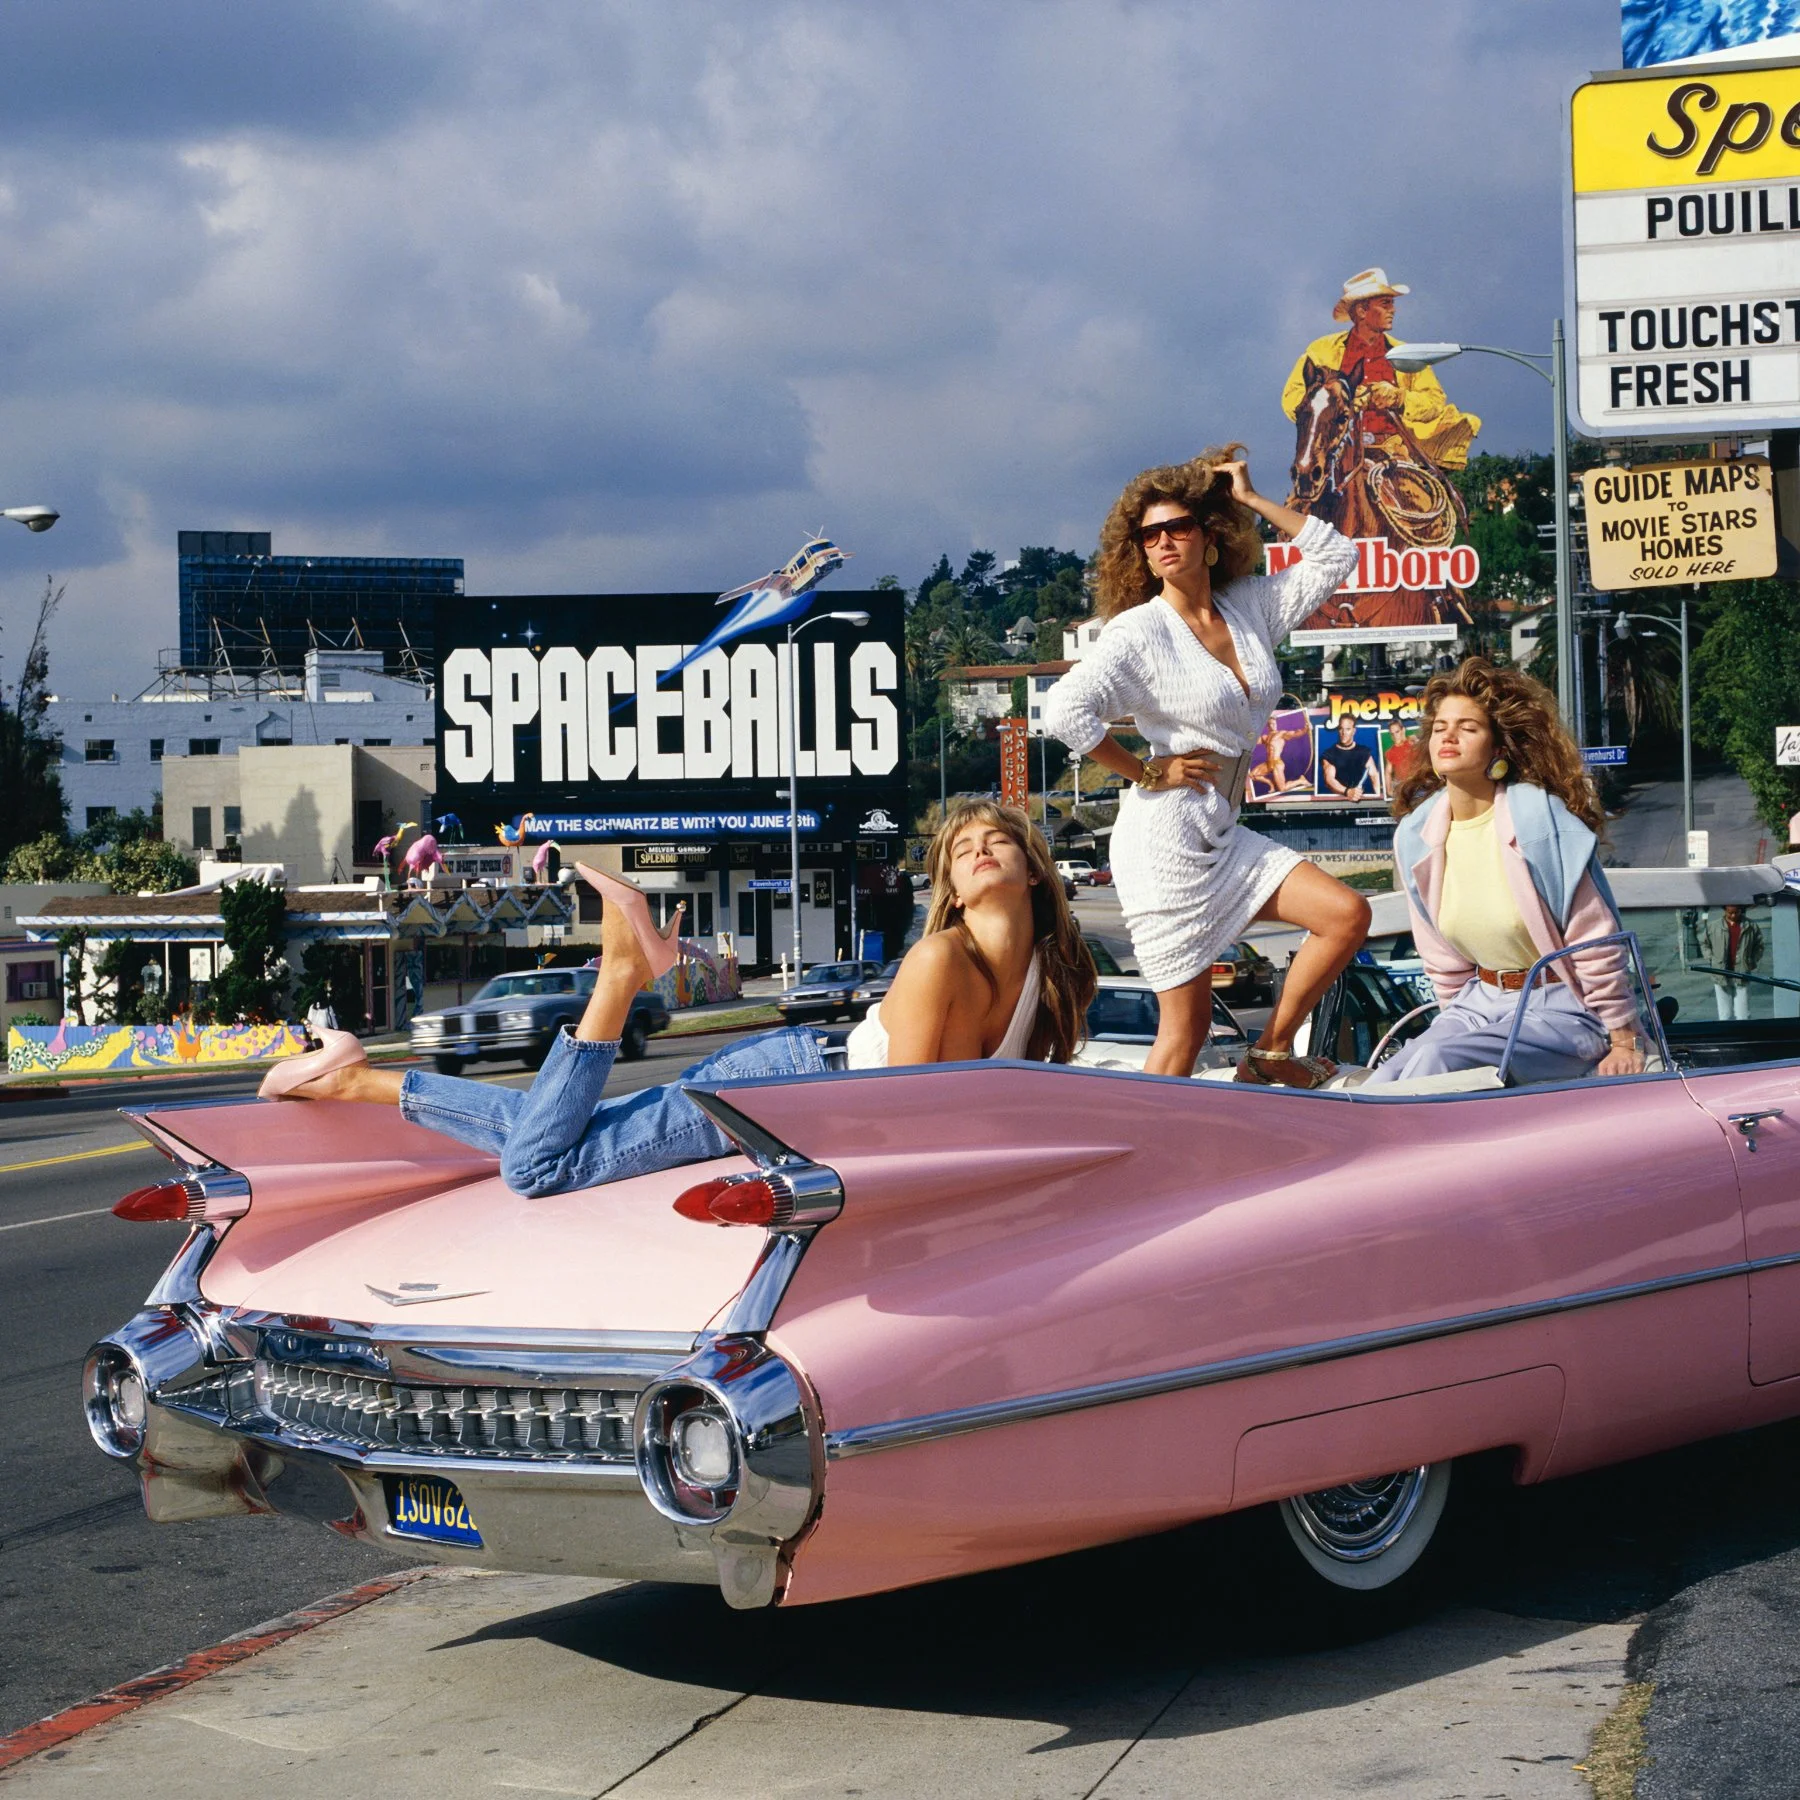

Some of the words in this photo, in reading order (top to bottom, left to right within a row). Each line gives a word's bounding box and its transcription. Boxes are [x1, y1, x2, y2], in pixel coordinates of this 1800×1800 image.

[1611, 359, 1750, 408] FRESH
[1594, 471, 1672, 504] GUIDE
[1685, 463, 1760, 496] MAPS
[1668, 501, 1688, 512] TO
[1602, 516, 1670, 542] MOVIE
[1681, 507, 1757, 534] STARS
[1267, 540, 1476, 590] Mlboro
[1640, 535, 1723, 561] HOMES
[1629, 565, 1678, 581] SOLD
[1686, 560, 1736, 576] HERE
[444, 642, 898, 783] SPACEBALLS
[1326, 694, 1378, 729] Joe
[1003, 721, 1014, 806] IMPERIA
[1583, 748, 1615, 761] avenhurst
[1616, 748, 1625, 760] Dr
[525, 819, 553, 832] MAY
[555, 819, 582, 831] THE
[584, 818, 658, 831] SCHWARTZ
[661, 817, 679, 829] BE
[681, 816, 715, 829] WITH
[718, 816, 747, 828] YOU
[750, 815, 784, 828] JUNE
[640, 854, 679, 864] SPLENDID
[1311, 854, 1322, 863] TO
[1324, 854, 1346, 863] WEST
[1349, 853, 1393, 863] HOLLYWOO
[397, 1481, 478, 1531] 1SOV62
